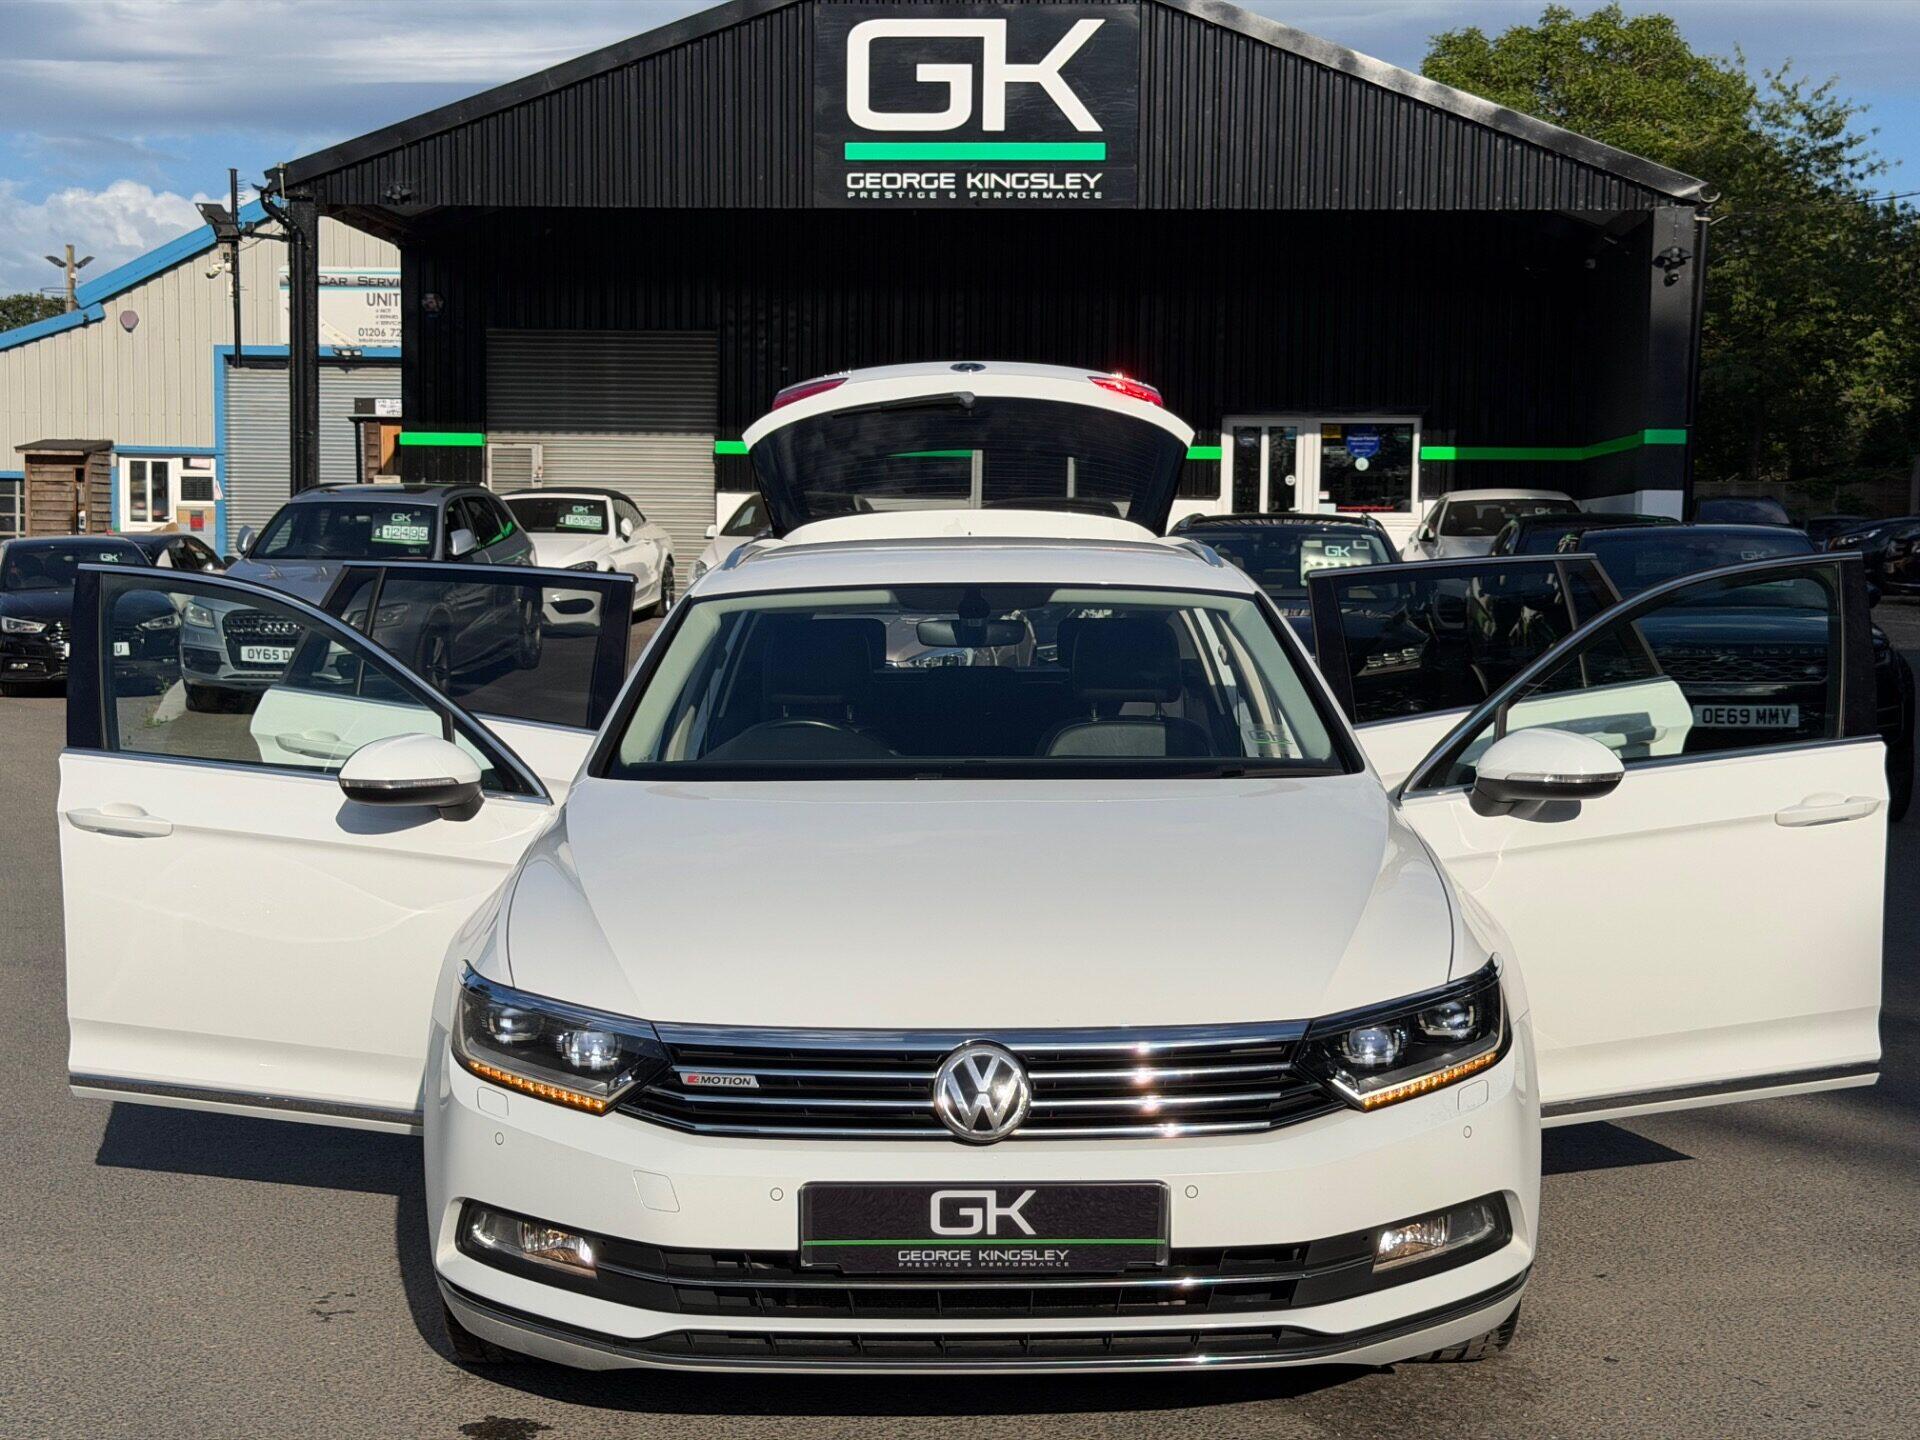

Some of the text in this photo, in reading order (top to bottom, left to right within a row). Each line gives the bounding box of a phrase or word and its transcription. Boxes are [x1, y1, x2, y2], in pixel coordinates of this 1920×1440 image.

[846, 18, 1106, 132] GK
[846, 172, 1103, 189] GEORGE KINGSLEY
[847, 191, 937, 199] PRESTIGE
[969, 191, 1103, 199] PERFORMANCE
[366, 292, 400, 307] UNIT
[358, 327, 386, 337] 01206
[391, 513, 411, 521] GK
[1325, 545, 1350, 557] GK
[100, 553, 119, 562] GK
[247, 648, 280, 660] OY65
[1702, 708, 1791, 725] OE69 MMV
[930, 1189, 1037, 1236] GK
[898, 1250, 1070, 1261] GEORGE KINGSLEY
